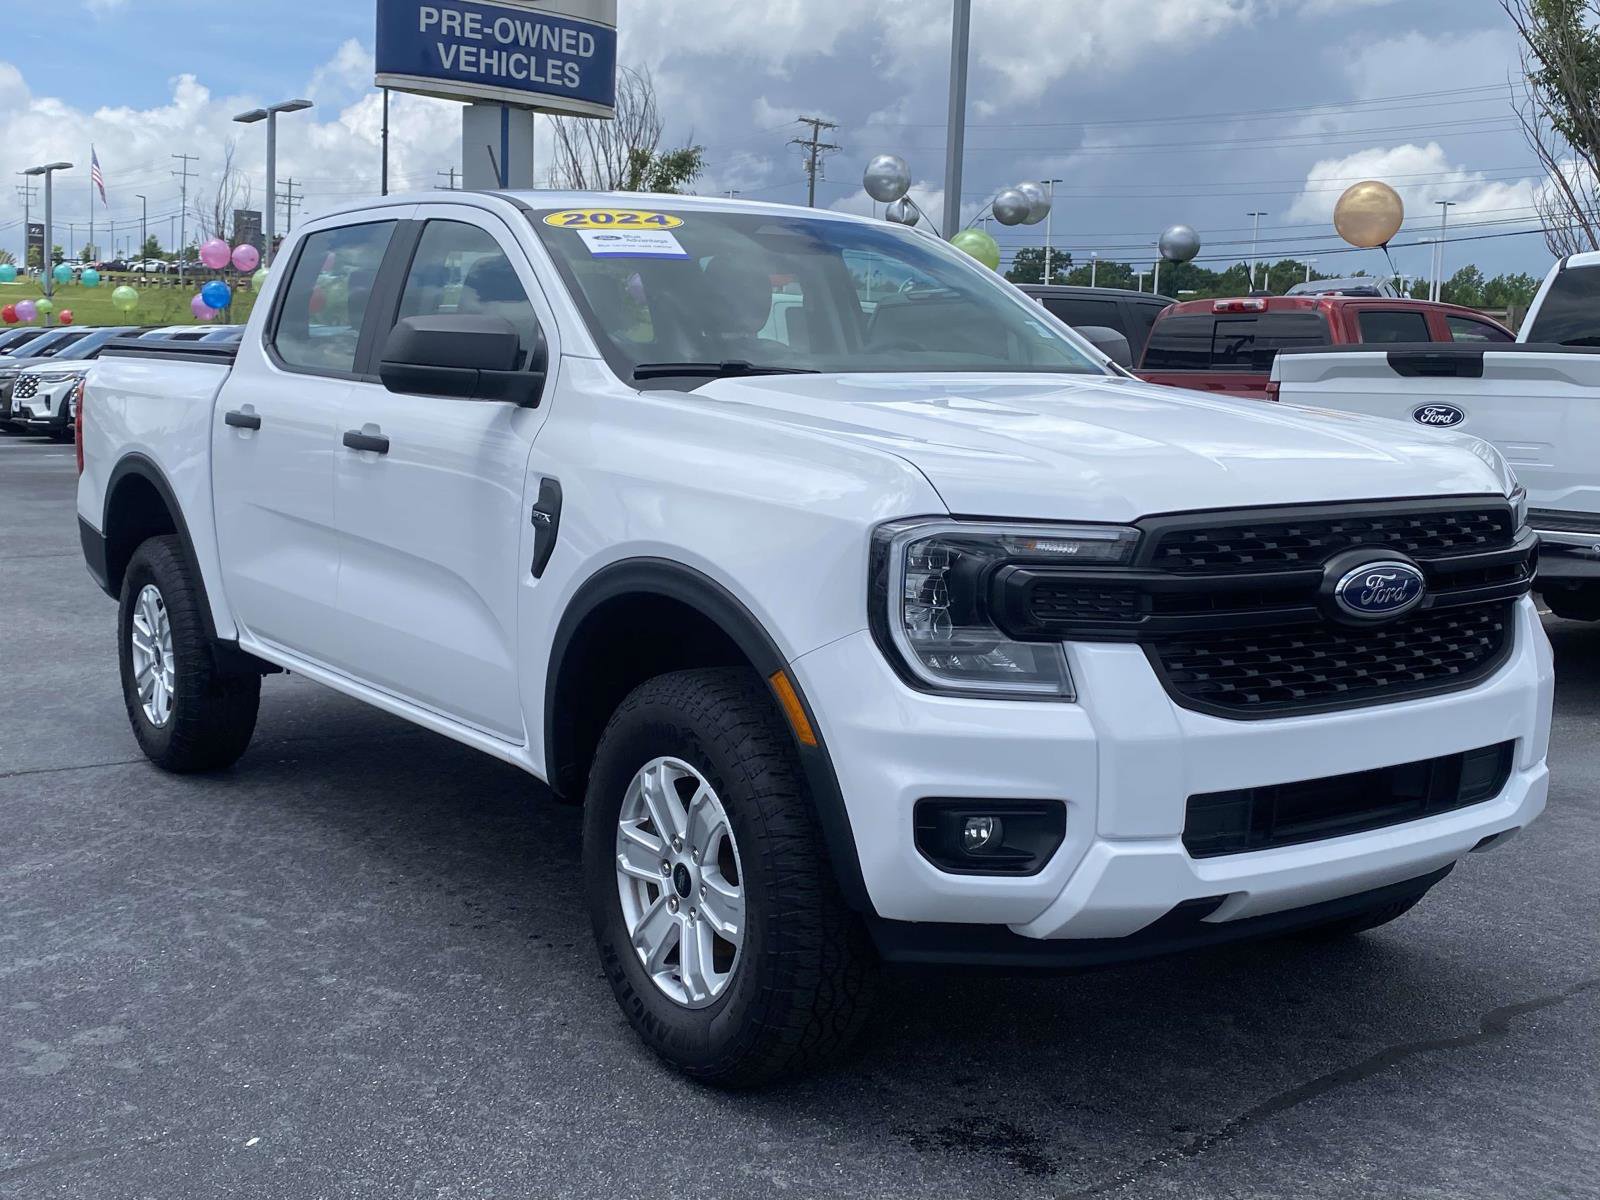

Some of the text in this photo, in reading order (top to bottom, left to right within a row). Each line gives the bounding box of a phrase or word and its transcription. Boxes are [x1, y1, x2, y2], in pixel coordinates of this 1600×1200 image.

[419, 6, 595, 58] PRE-OWNED
[437, 42, 580, 88] VEHICLES
[562, 212, 670, 226] 2024
[1420, 407, 1454, 423] Ford
[1360, 574, 1408, 605] Ford
